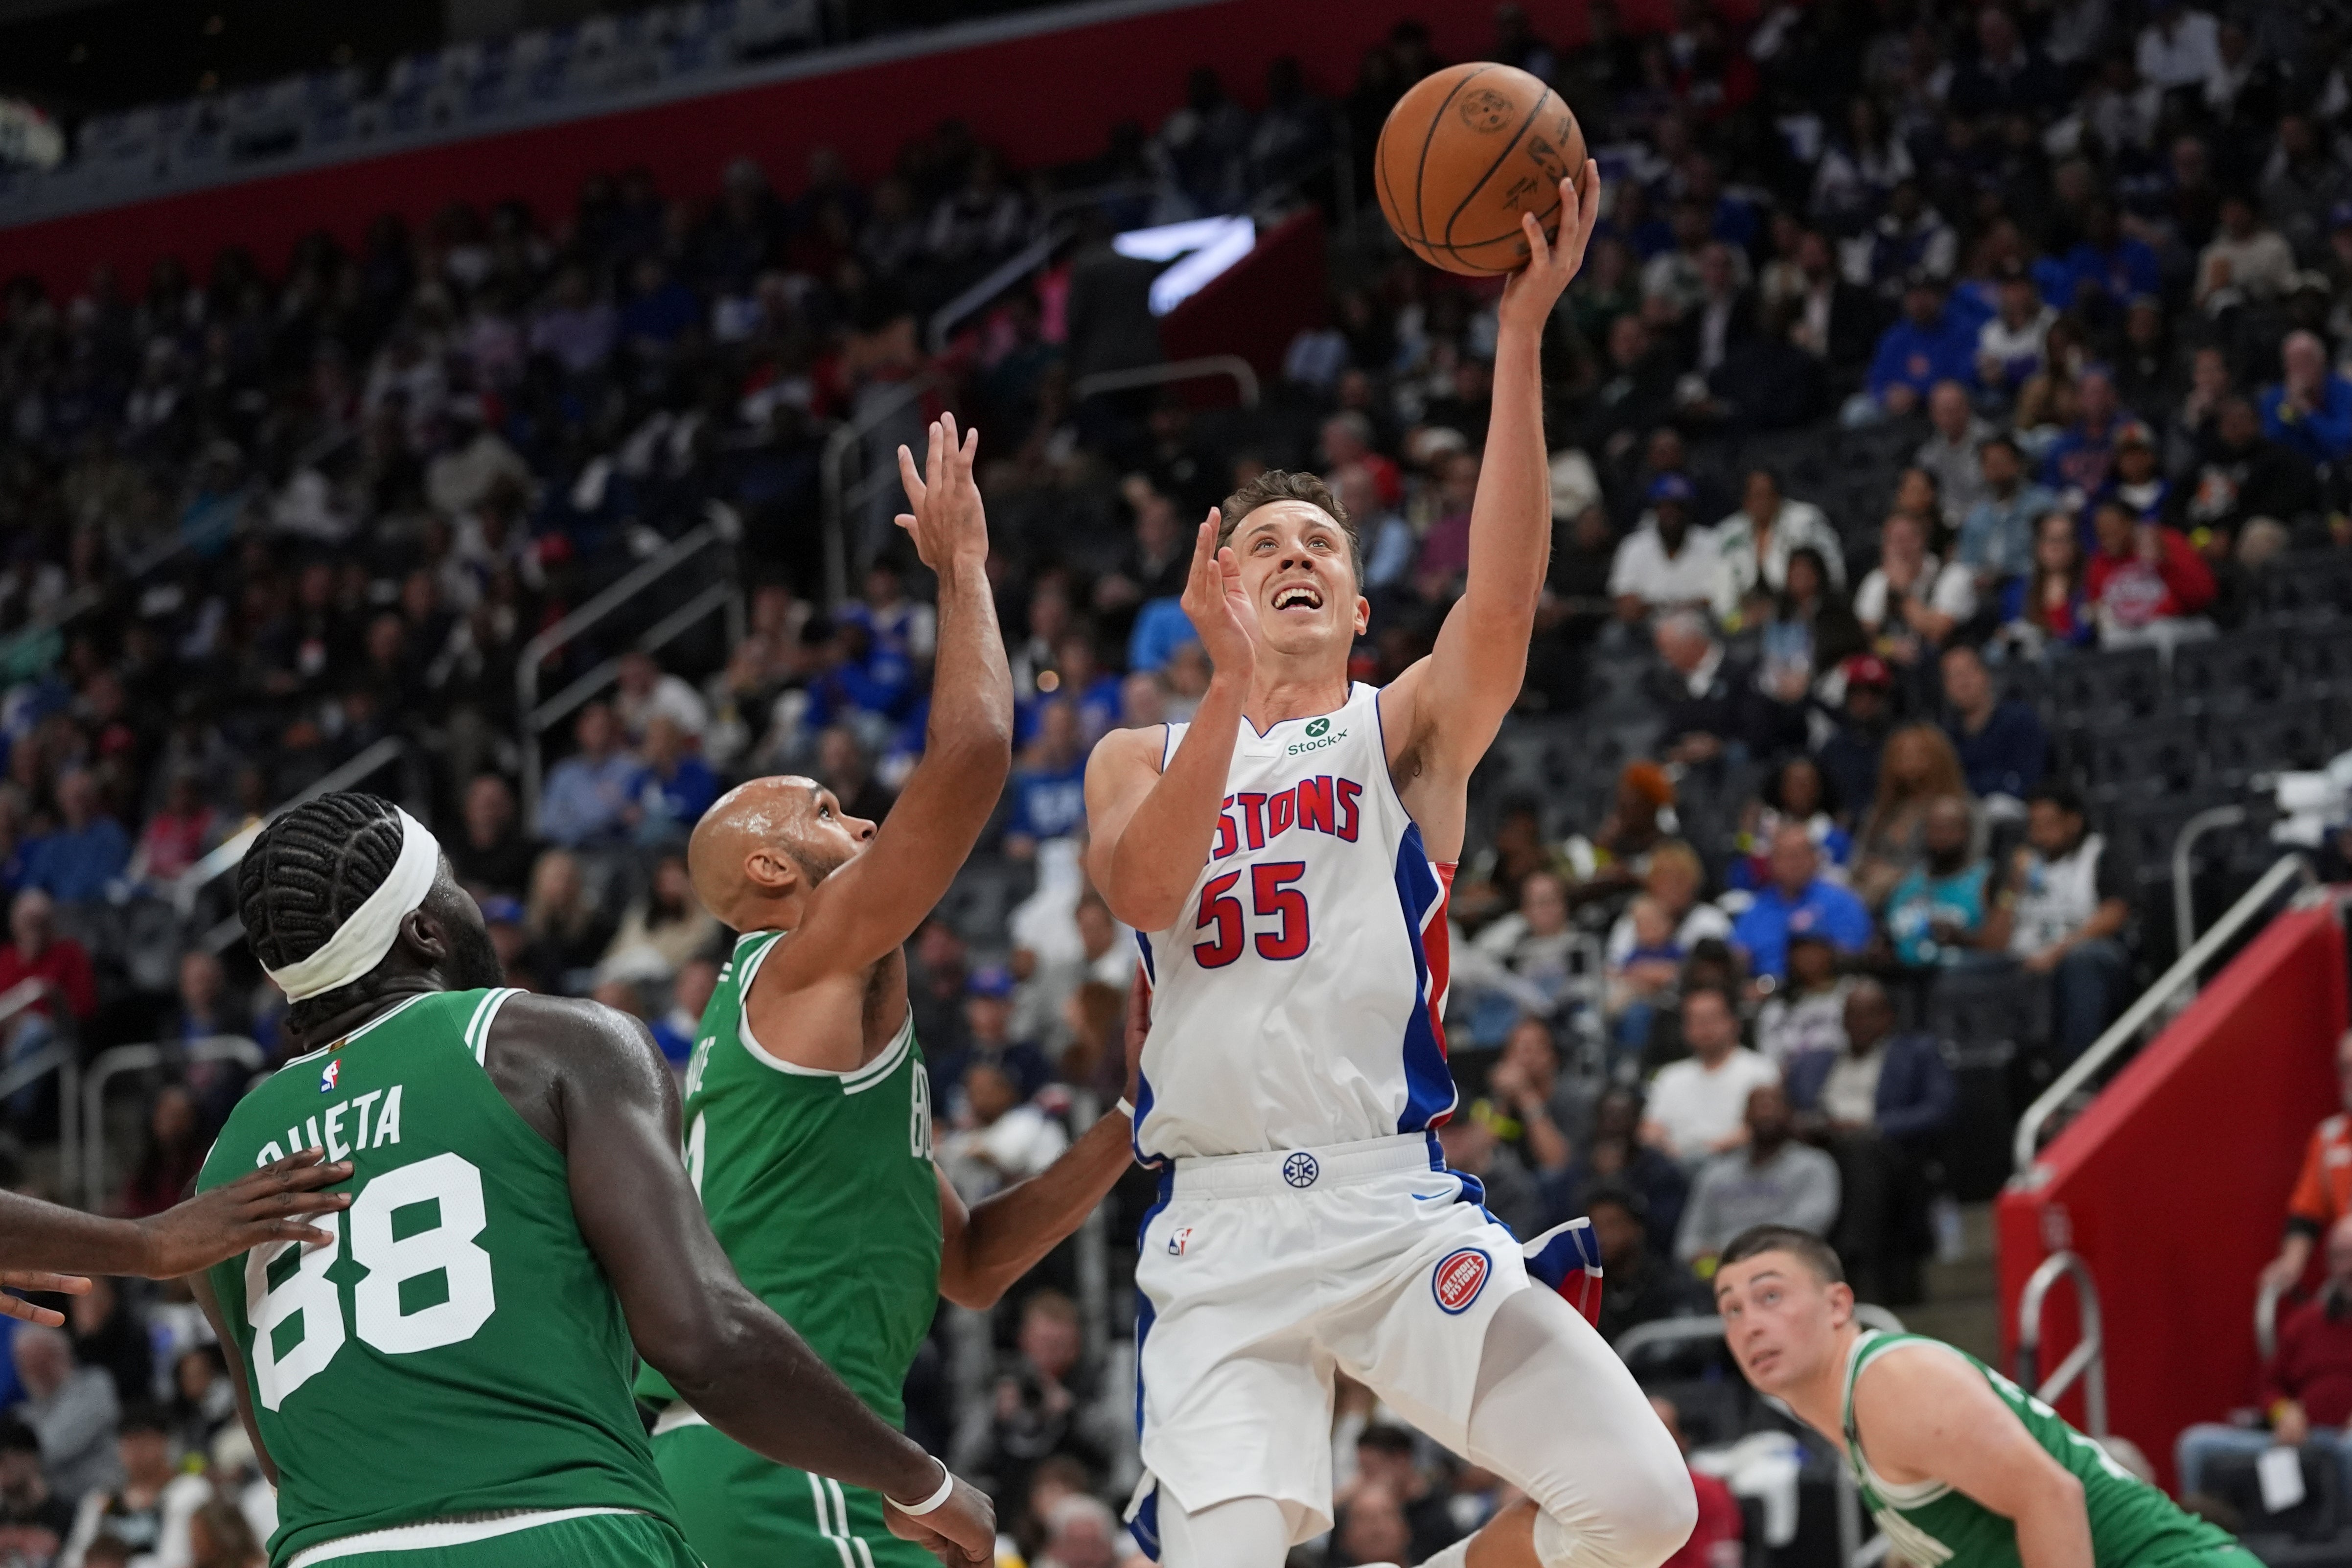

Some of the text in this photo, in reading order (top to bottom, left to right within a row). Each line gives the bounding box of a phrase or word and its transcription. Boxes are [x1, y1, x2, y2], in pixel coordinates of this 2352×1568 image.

[1288, 728, 1347, 755] StockX
[1206, 775, 1362, 865] STONS
[1193, 861, 1310, 968] 55
[245, 1152, 496, 1412] 88
[1442, 1257, 1474, 1293] DETROIT
[1448, 1263, 1481, 1302] PISTONS
